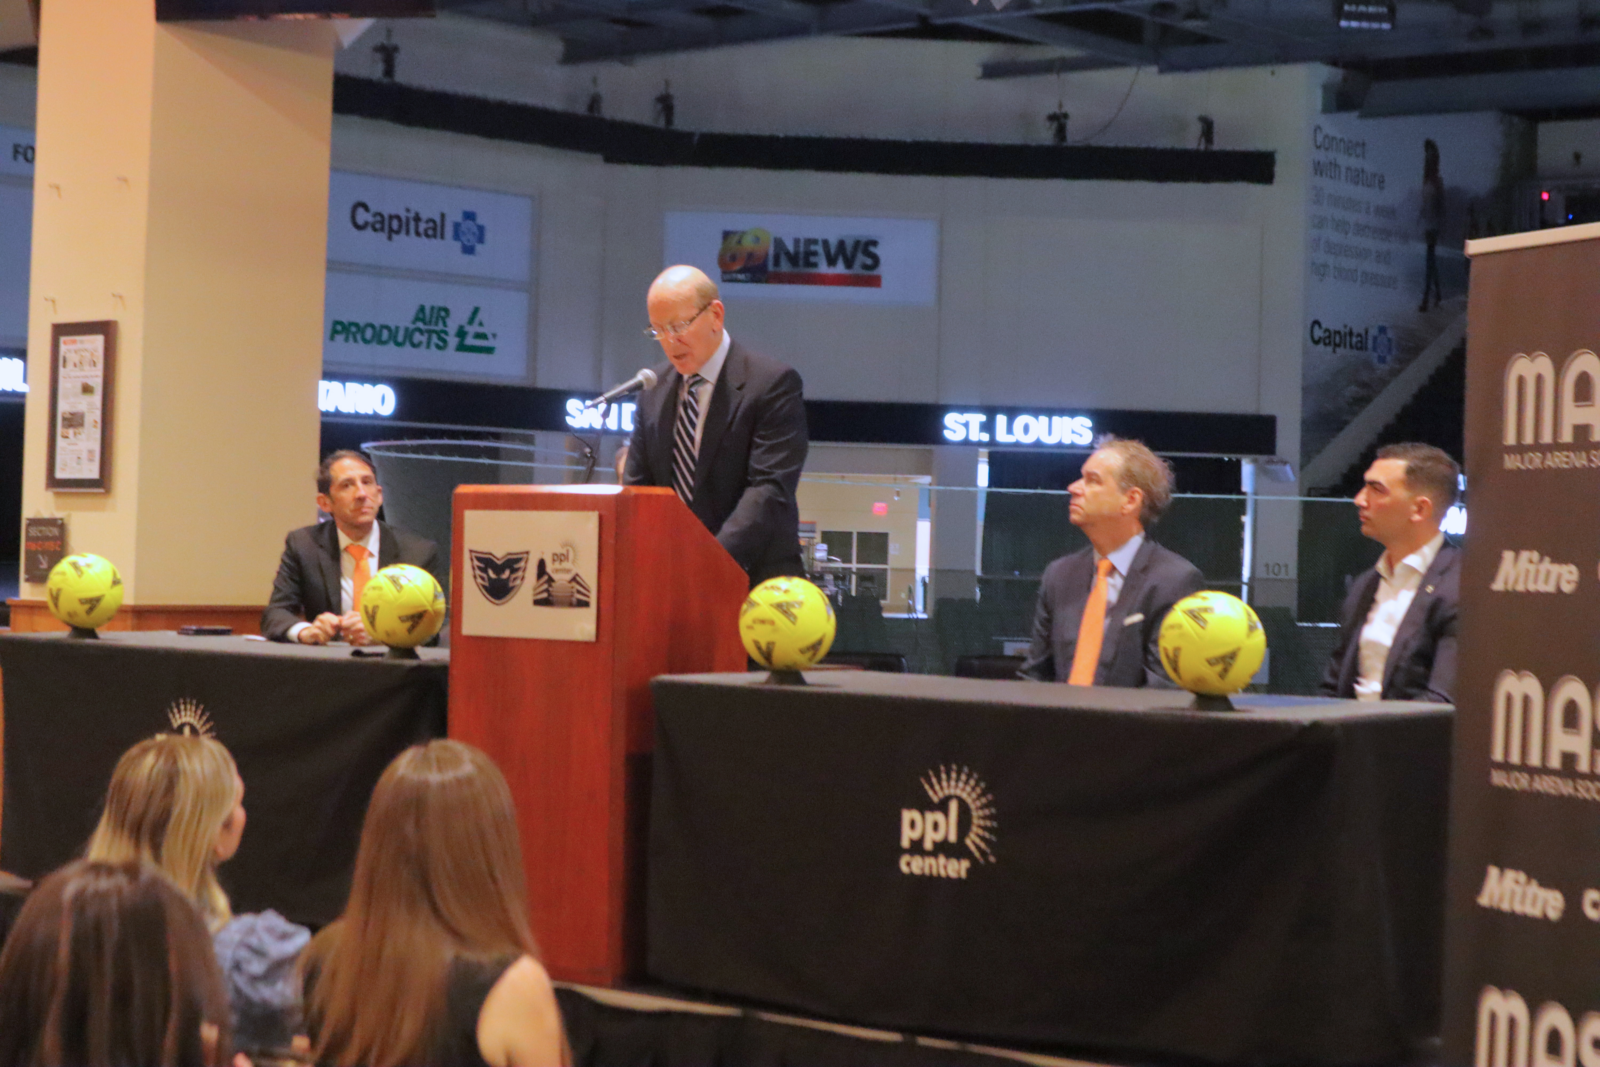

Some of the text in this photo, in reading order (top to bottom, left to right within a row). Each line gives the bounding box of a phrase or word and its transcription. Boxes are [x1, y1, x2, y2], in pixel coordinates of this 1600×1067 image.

[1313, 124, 1366, 159] Connect
[1312, 157, 1386, 191] with nature
[350, 200, 446, 241] Capital
[772, 236, 881, 271] NEWS
[411, 304, 450, 328] AIR
[329, 320, 450, 351] PRODUCTS
[1309, 319, 1369, 353] Capital
[943, 412, 1093, 445] ST. LOUIS
[1544, 450, 1588, 469] ARENA
[552, 549, 570, 565] ppl
[1264, 562, 1289, 576] 101
[1490, 549, 1580, 594] Mitre
[900, 797, 959, 851] ppl
[899, 853, 971, 879] center
[1477, 863, 1566, 922] Mitre
